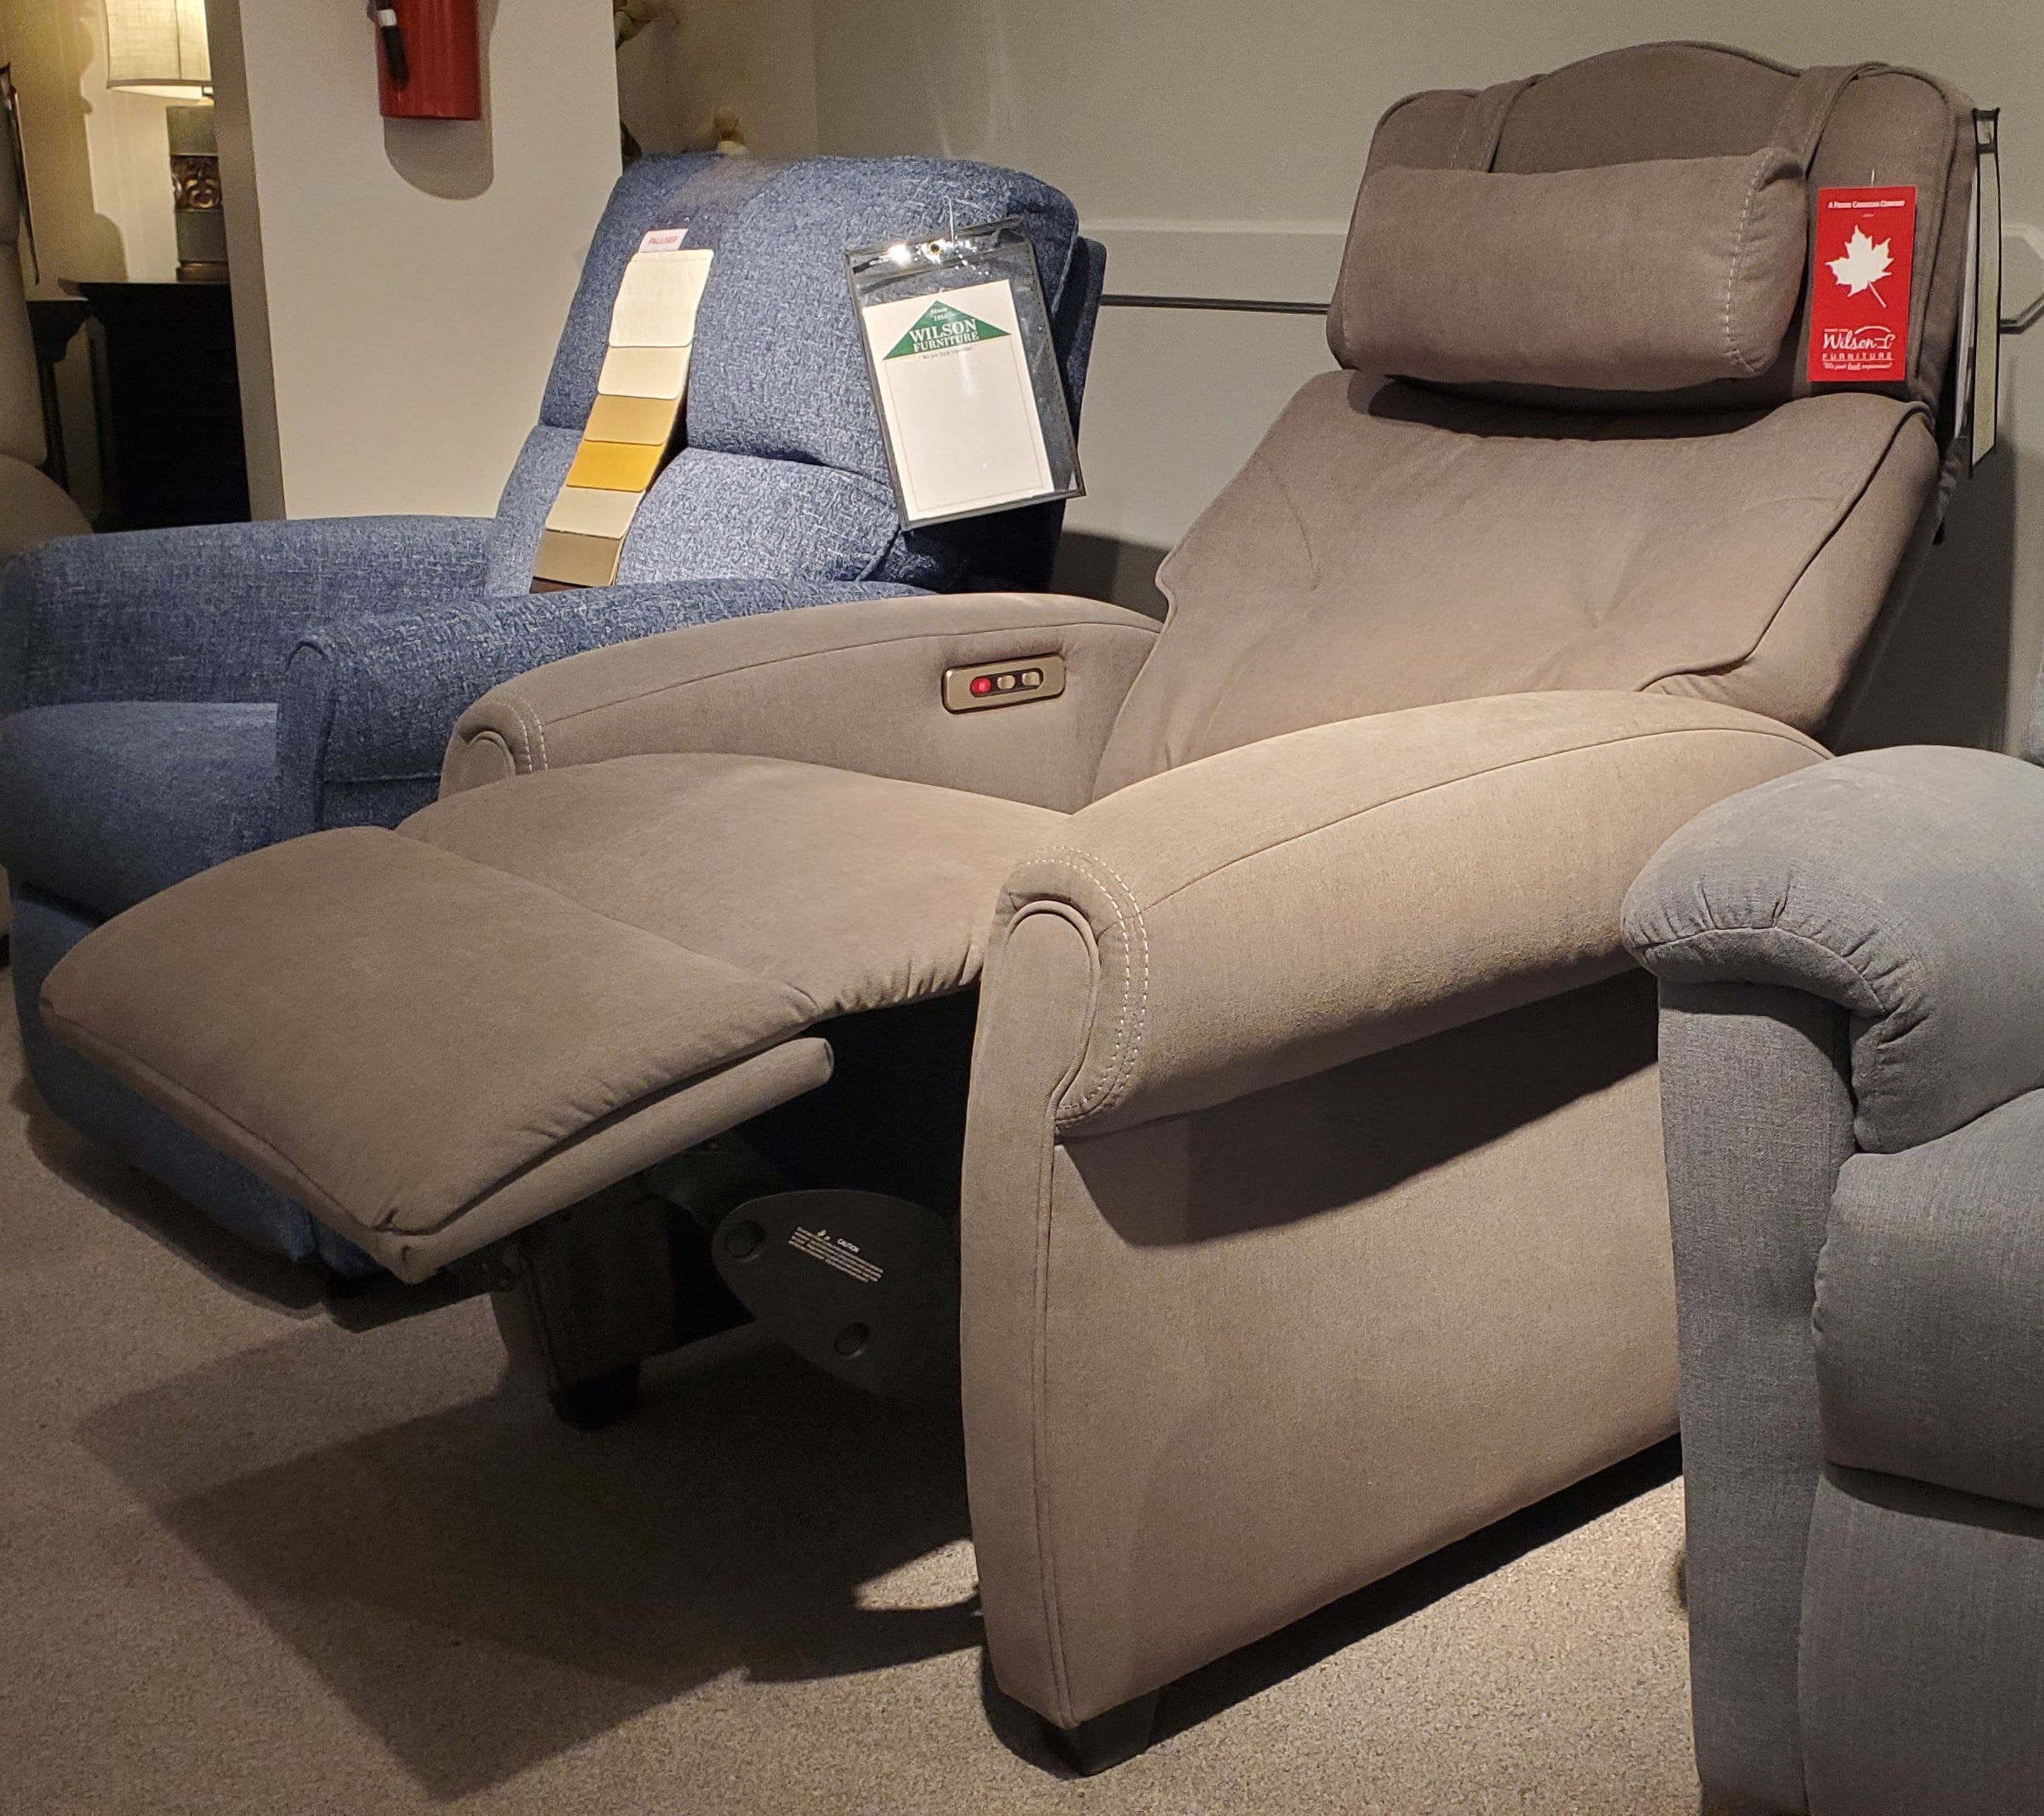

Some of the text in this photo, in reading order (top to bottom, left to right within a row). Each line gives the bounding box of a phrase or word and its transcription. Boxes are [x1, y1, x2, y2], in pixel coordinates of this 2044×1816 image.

[909, 318, 977, 343] WILSON
[1823, 330, 1878, 349] Wilson
[913, 331, 980, 353] FURNITURE
[1822, 351, 1892, 362] FURNITURE
[836, 1238, 860, 1253] CAUTION
